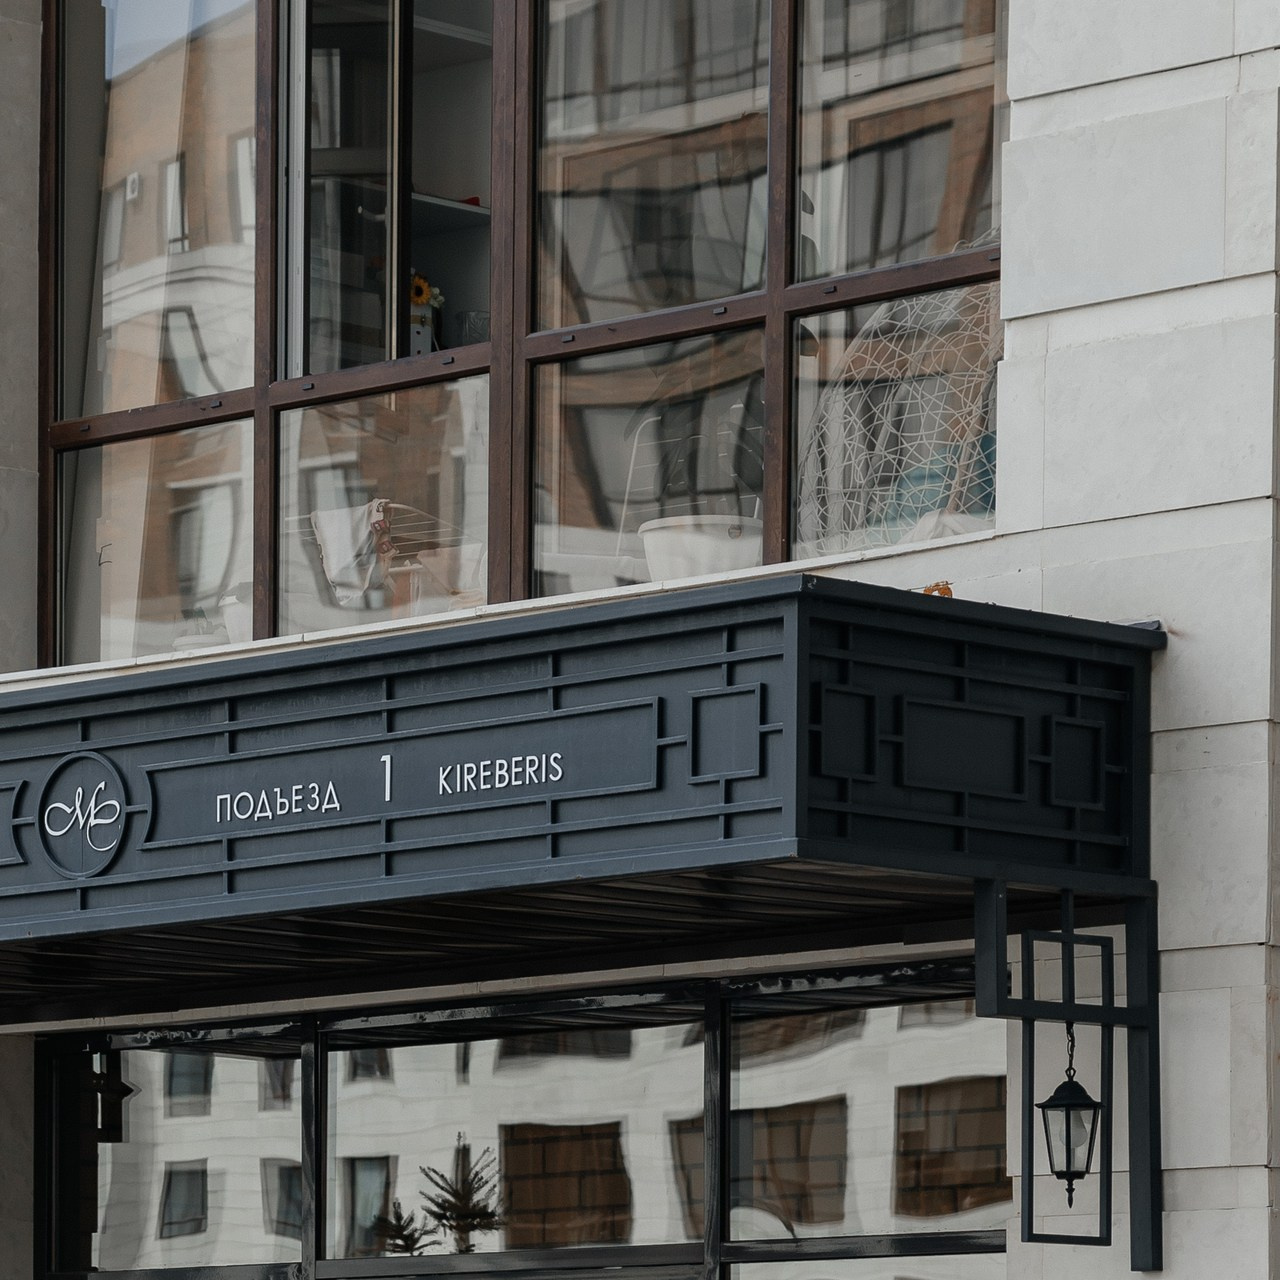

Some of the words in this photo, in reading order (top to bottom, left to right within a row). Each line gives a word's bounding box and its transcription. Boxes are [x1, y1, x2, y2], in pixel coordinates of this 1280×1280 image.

[216, 780, 340, 823] ПОДЪЕЗД
[379, 753, 392, 802] 1
[438, 752, 563, 795] KIREBERIS
